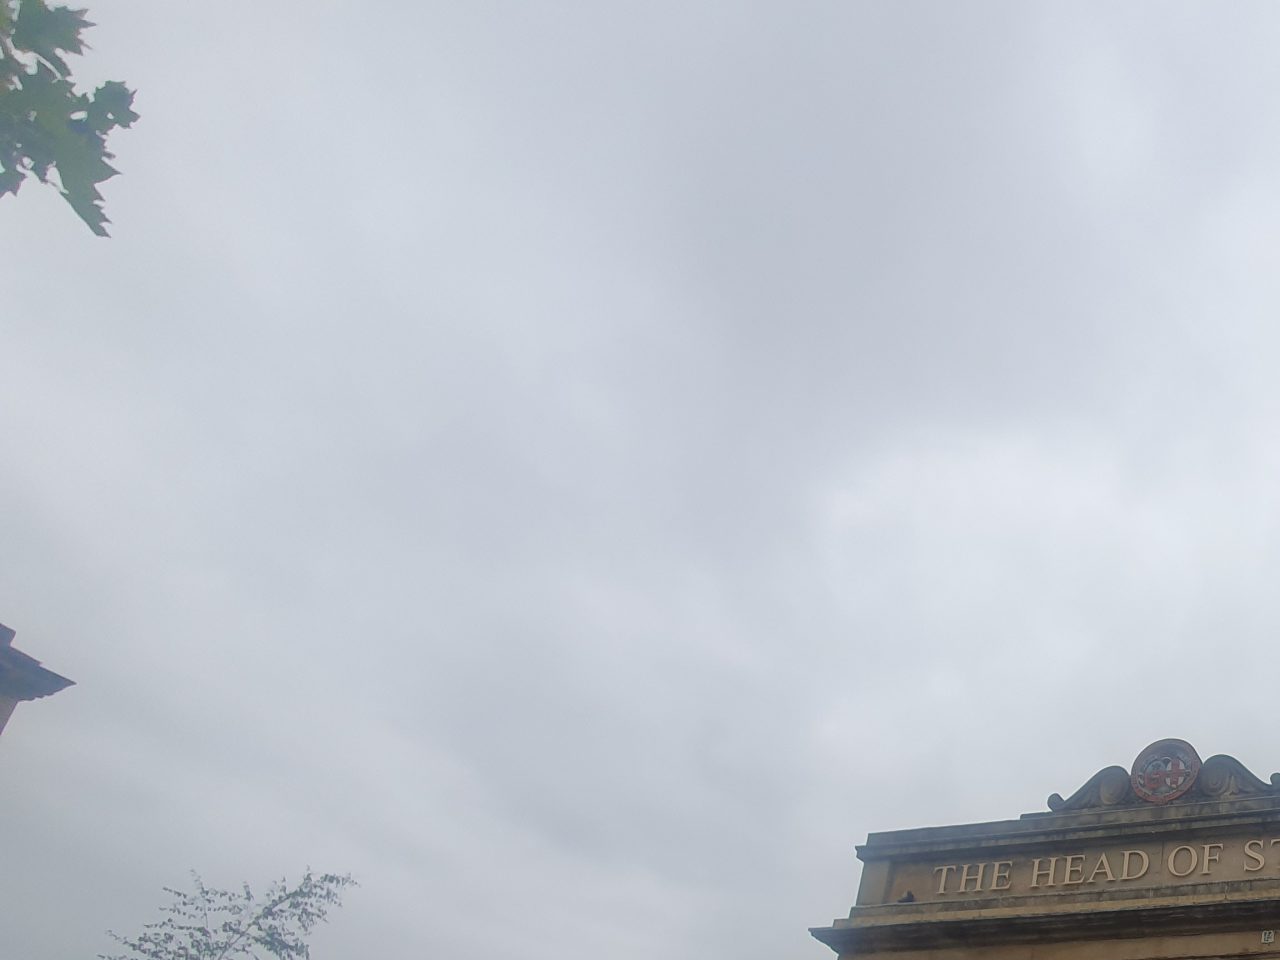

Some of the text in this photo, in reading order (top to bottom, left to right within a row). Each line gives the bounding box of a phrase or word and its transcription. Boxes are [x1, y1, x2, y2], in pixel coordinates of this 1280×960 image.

[933, 860, 1014, 895] THE
[1029, 849, 1149, 888] HEAD
[1167, 843, 1224, 877] OF
